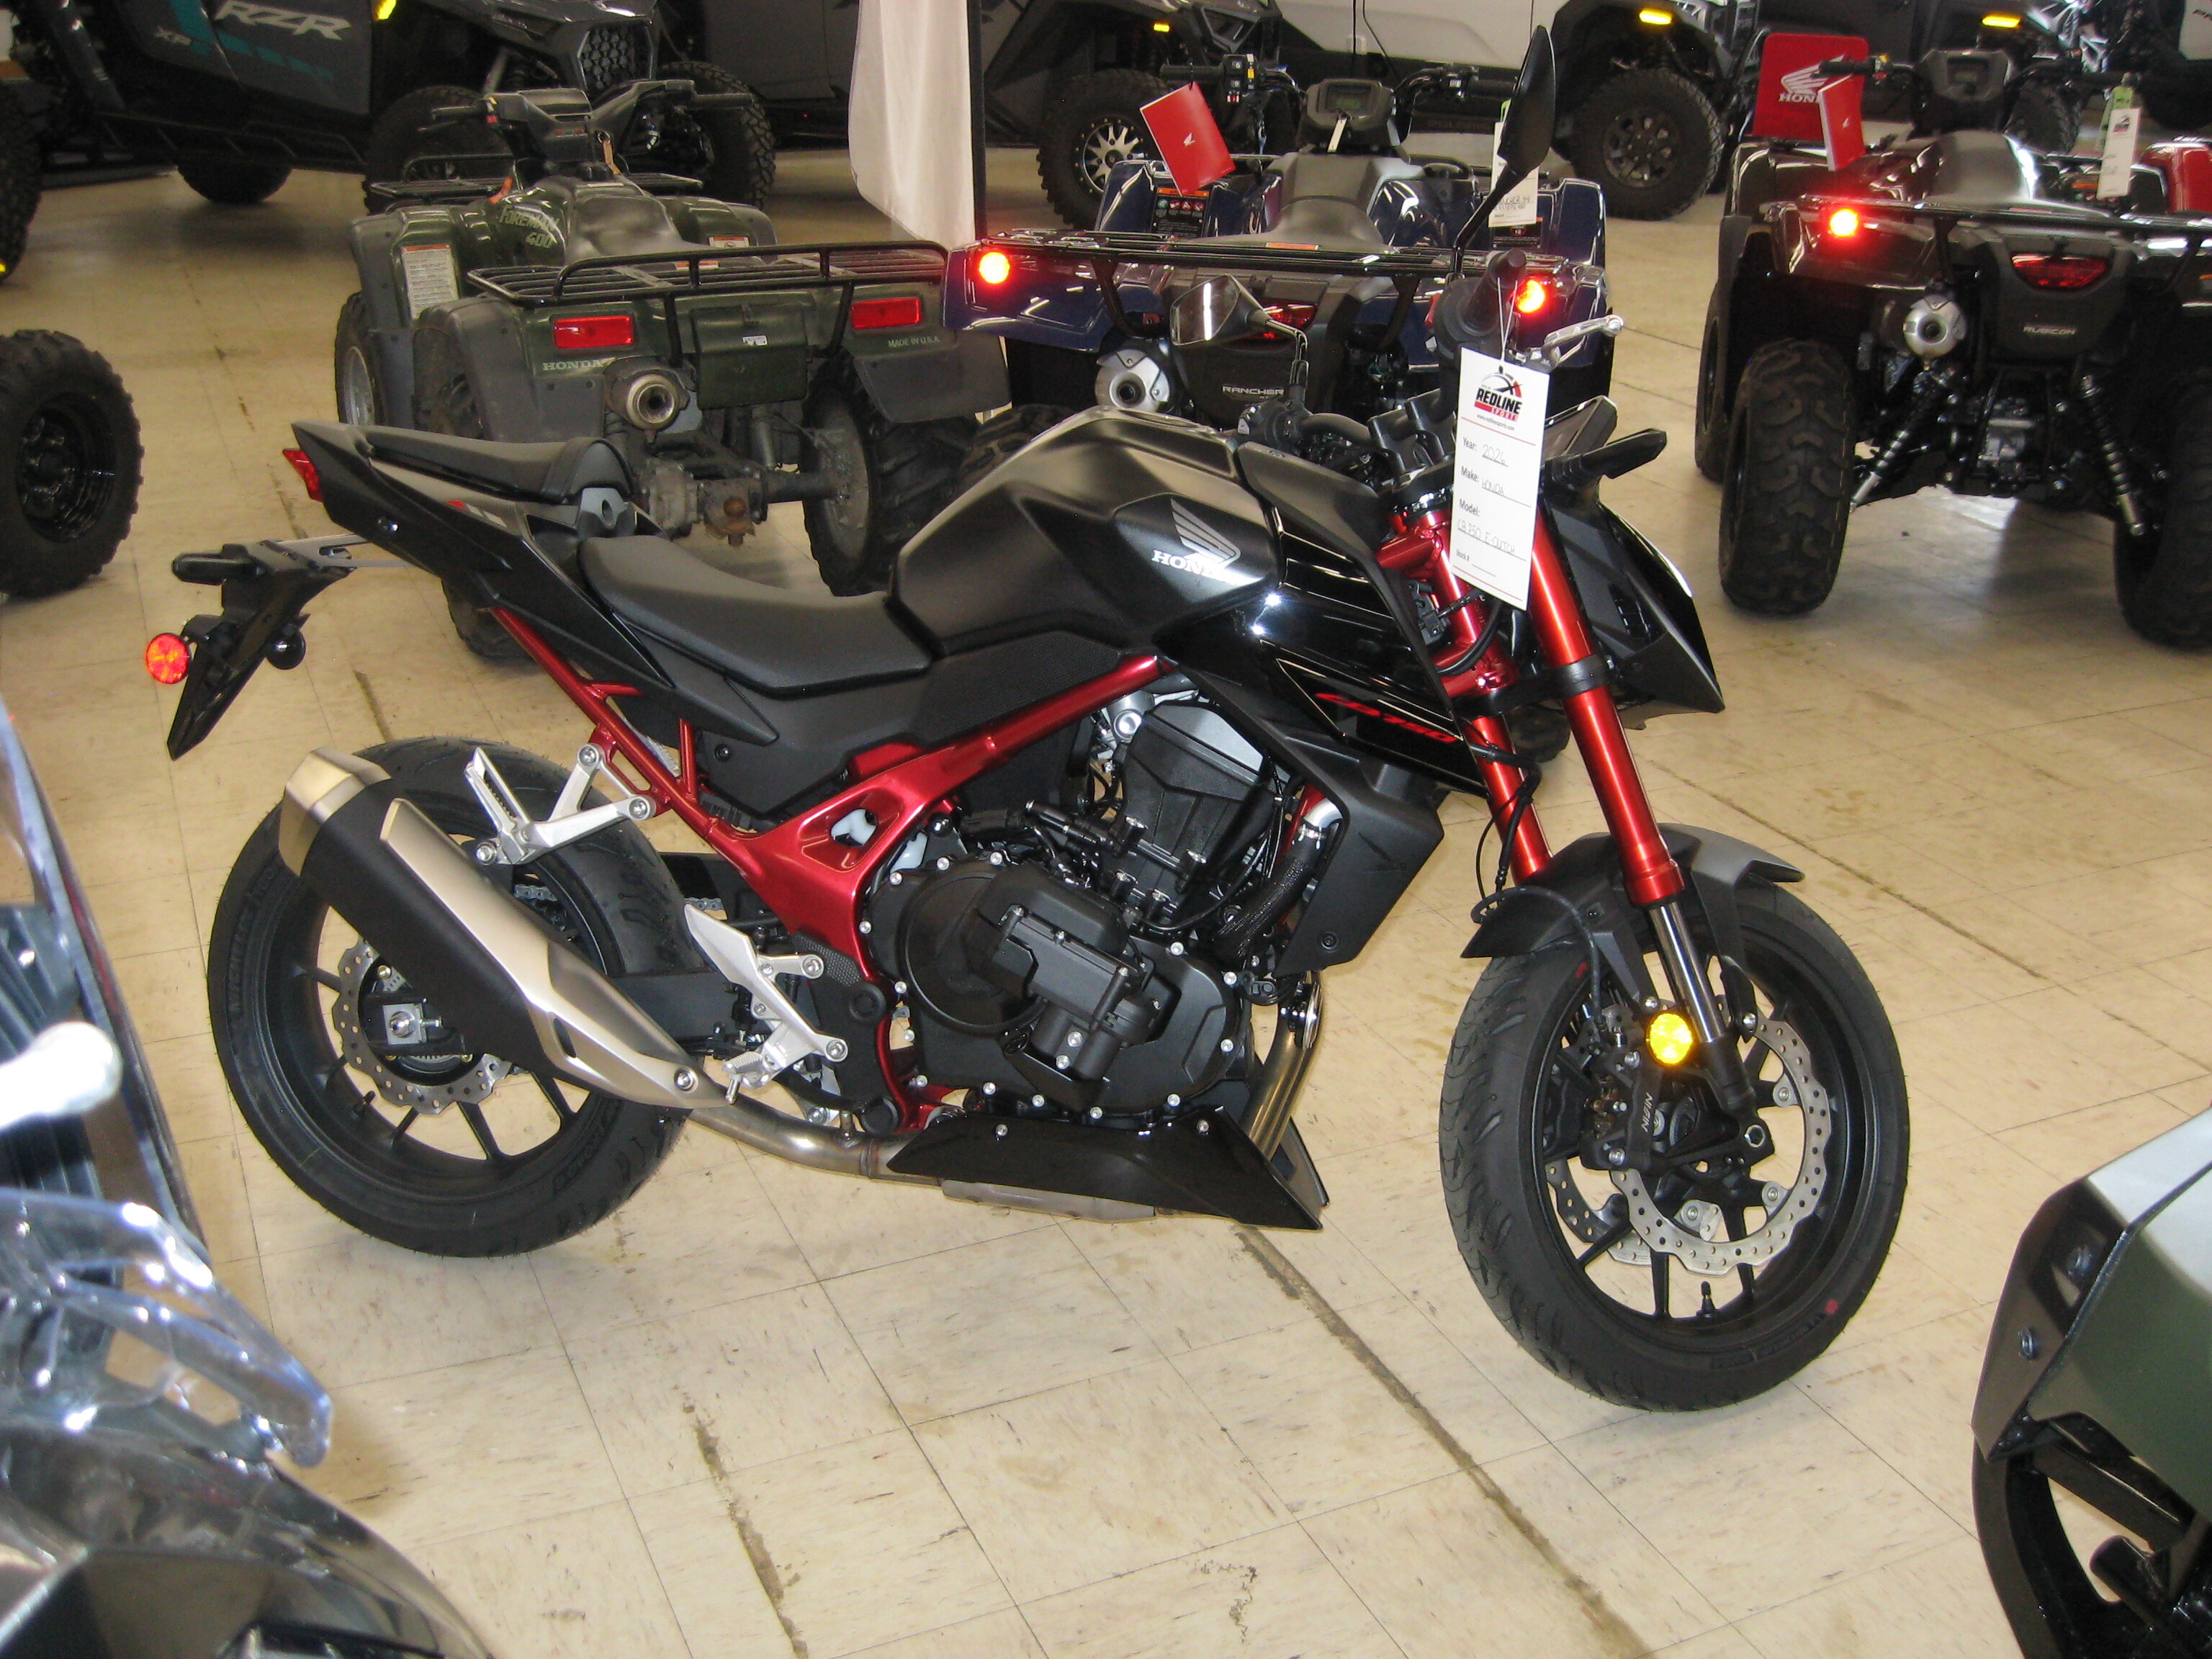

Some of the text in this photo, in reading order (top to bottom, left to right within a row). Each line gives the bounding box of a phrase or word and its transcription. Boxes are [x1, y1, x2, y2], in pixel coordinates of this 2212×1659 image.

[215, 0, 352, 41] RZR
[1779, 93, 1820, 104] HON
[2023, 326, 2077, 336] RUBICON
[541, 359, 604, 371] HONDA
[1222, 385, 1285, 395] RANCHER
[1476, 387, 1523, 415] REDLINE
[1491, 407, 1519, 423] SPORTS
[1462, 436, 1477, 451] Year:
[1460, 465, 1506, 496] Make: HONDA
[1459, 498, 1480, 517] Model:
